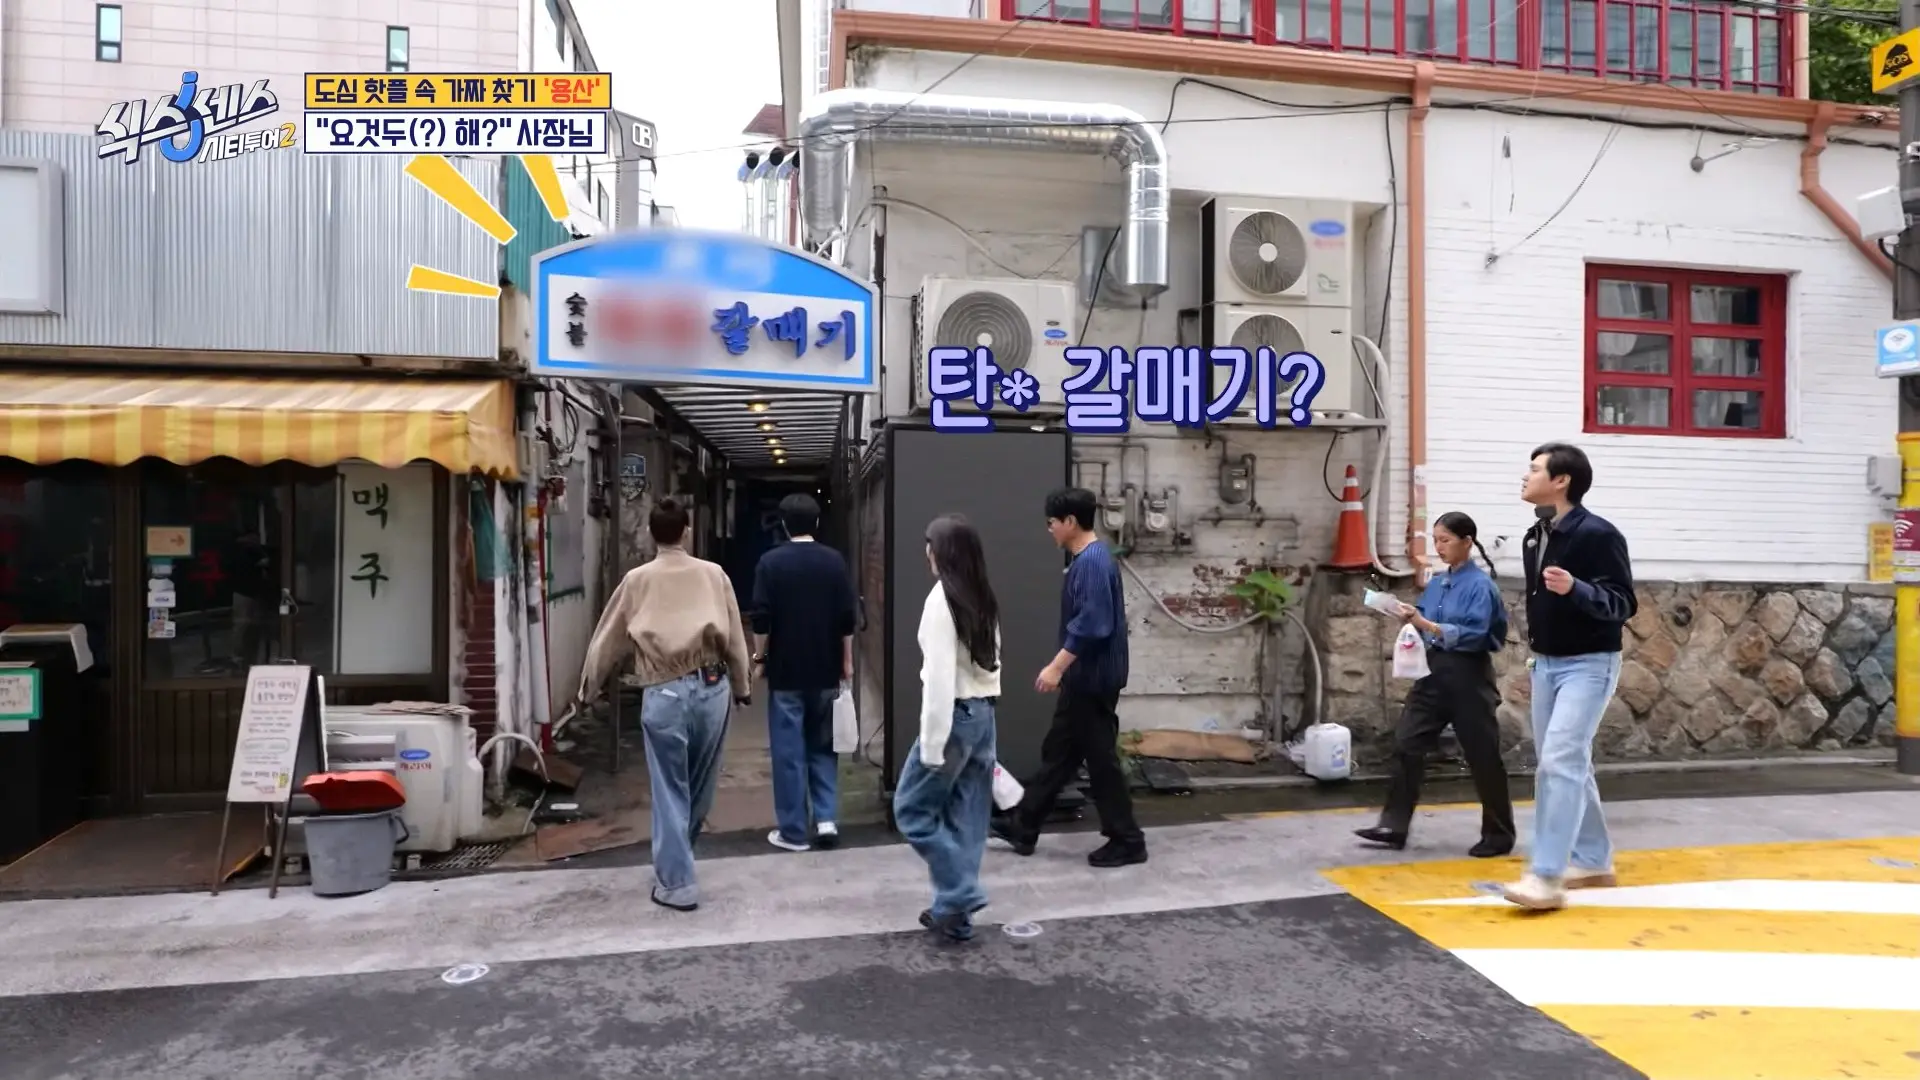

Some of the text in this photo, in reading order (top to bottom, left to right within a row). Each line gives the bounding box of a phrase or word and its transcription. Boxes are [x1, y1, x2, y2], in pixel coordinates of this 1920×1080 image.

[565, 291, 589, 347] 숯불
[710, 300, 856, 362] 갈매기
[350, 482, 390, 600] 맥주
